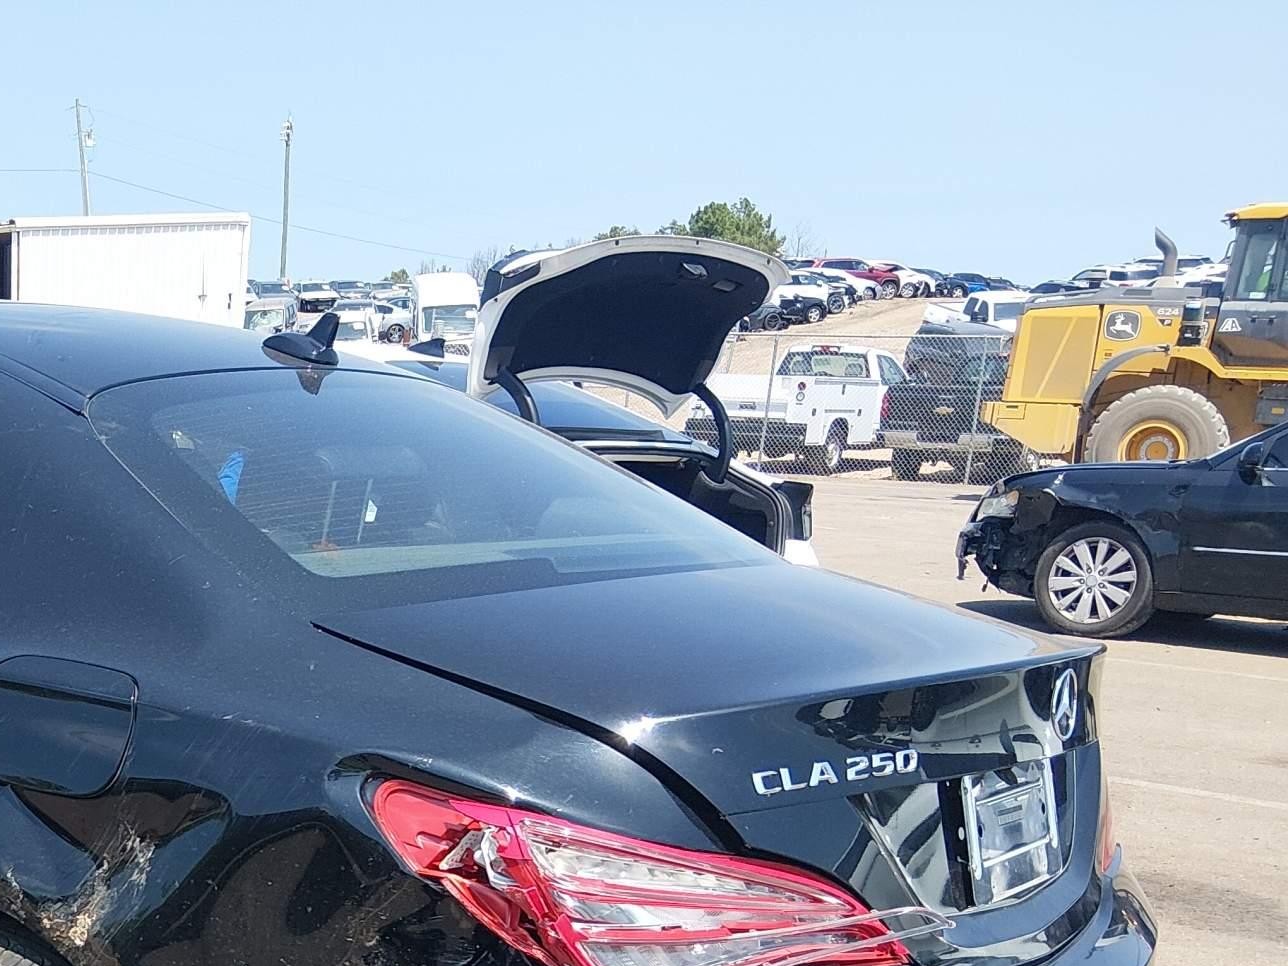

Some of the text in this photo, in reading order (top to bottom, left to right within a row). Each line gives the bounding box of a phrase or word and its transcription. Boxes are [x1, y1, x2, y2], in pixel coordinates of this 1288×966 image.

[1156, 307, 1180, 317] 624
[752, 749, 918, 795] CLA 250
